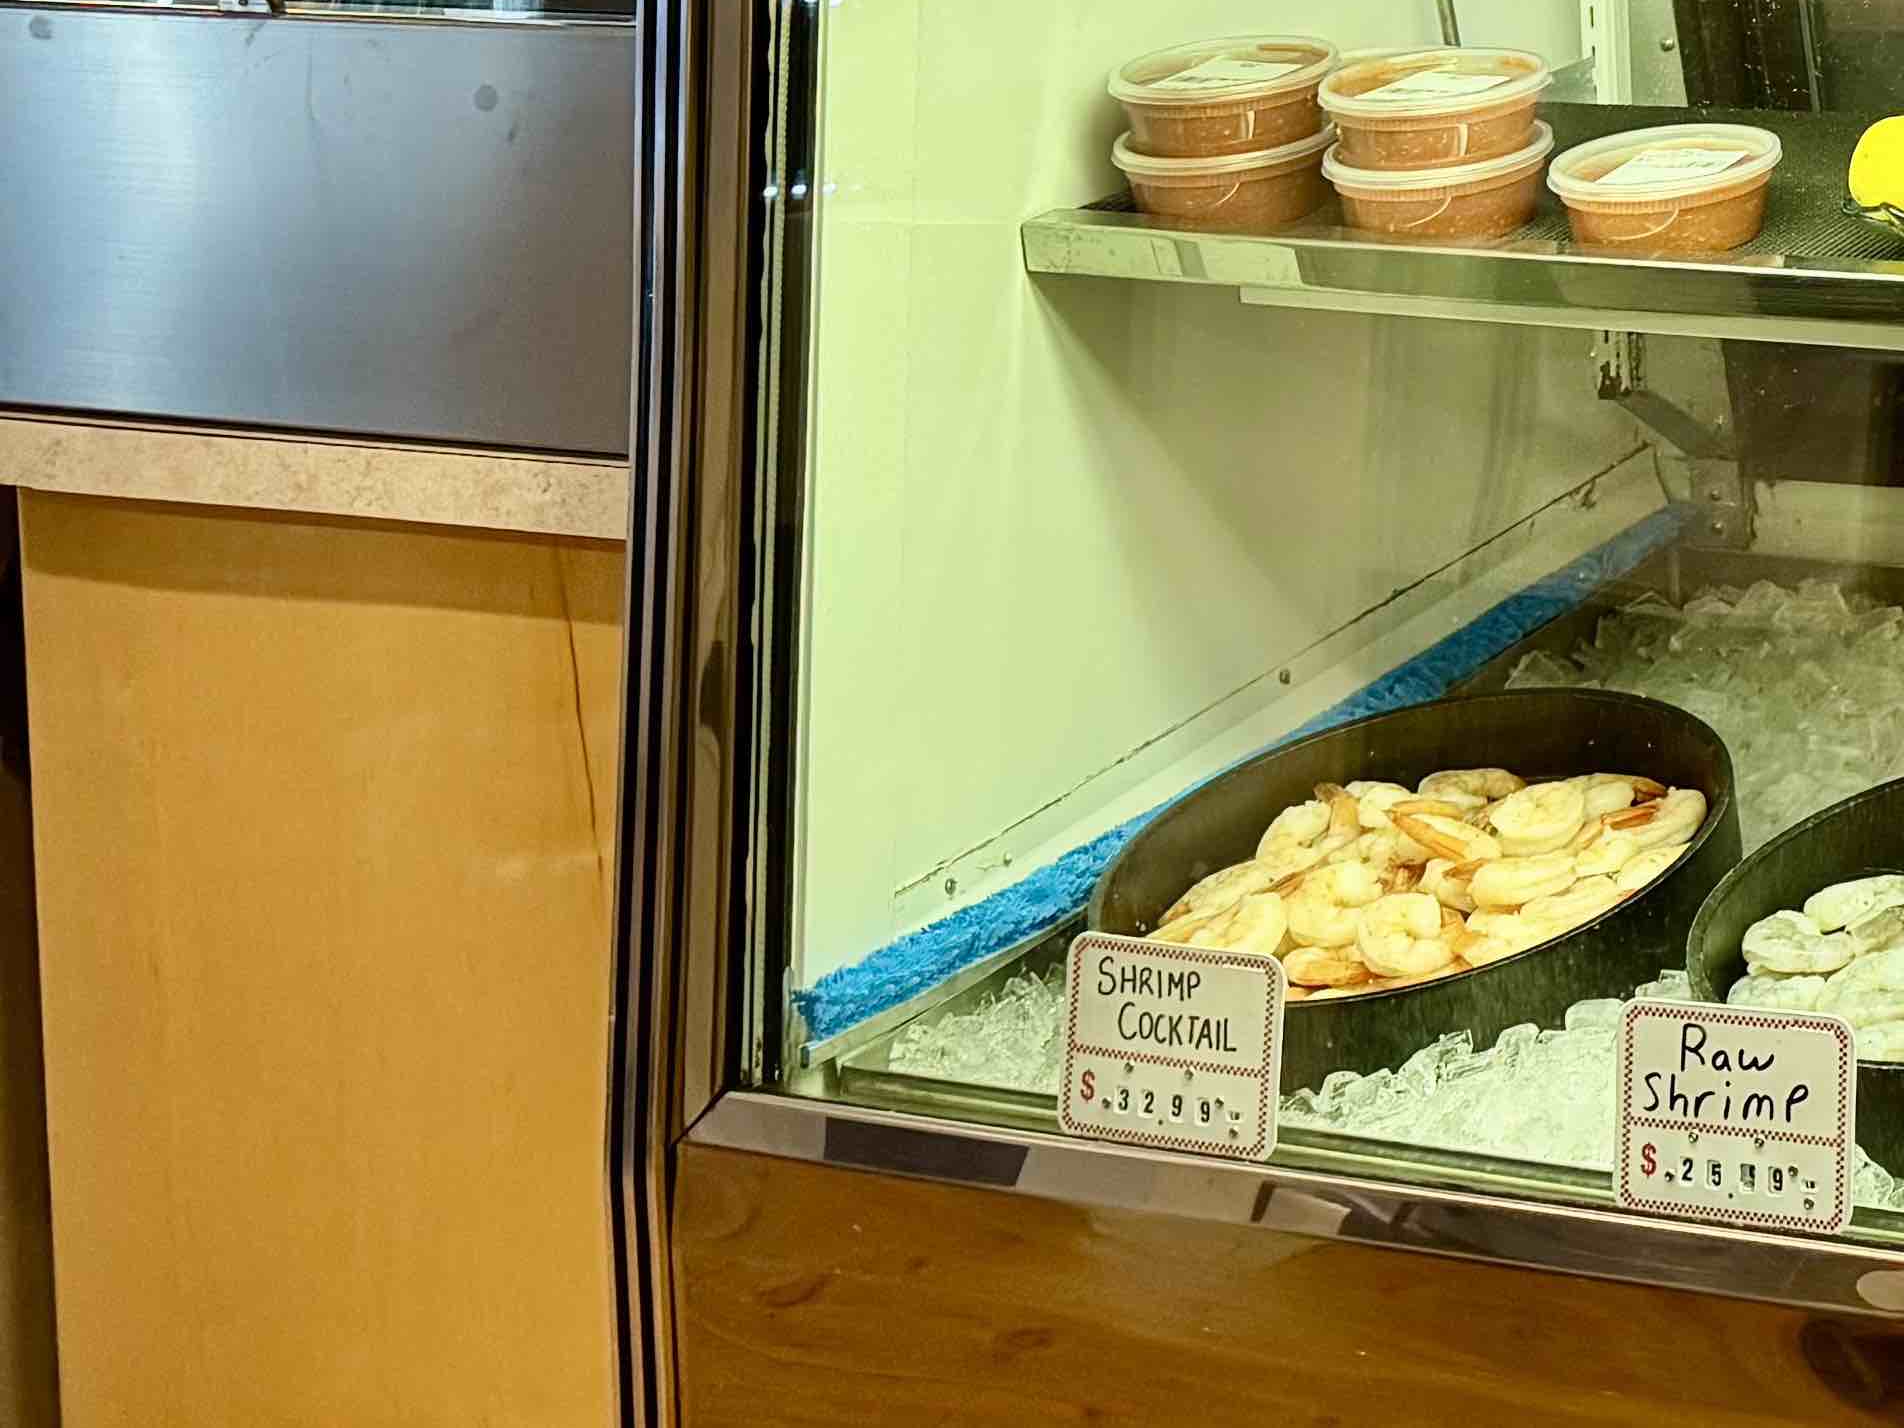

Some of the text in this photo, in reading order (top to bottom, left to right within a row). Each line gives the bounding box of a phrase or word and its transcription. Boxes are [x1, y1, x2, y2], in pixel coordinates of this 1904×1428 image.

[1098, 956, 1201, 1002] SHRIMP
[1118, 1001, 1238, 1052] COCKTAIL
[1681, 1023, 1774, 1072] Raw
